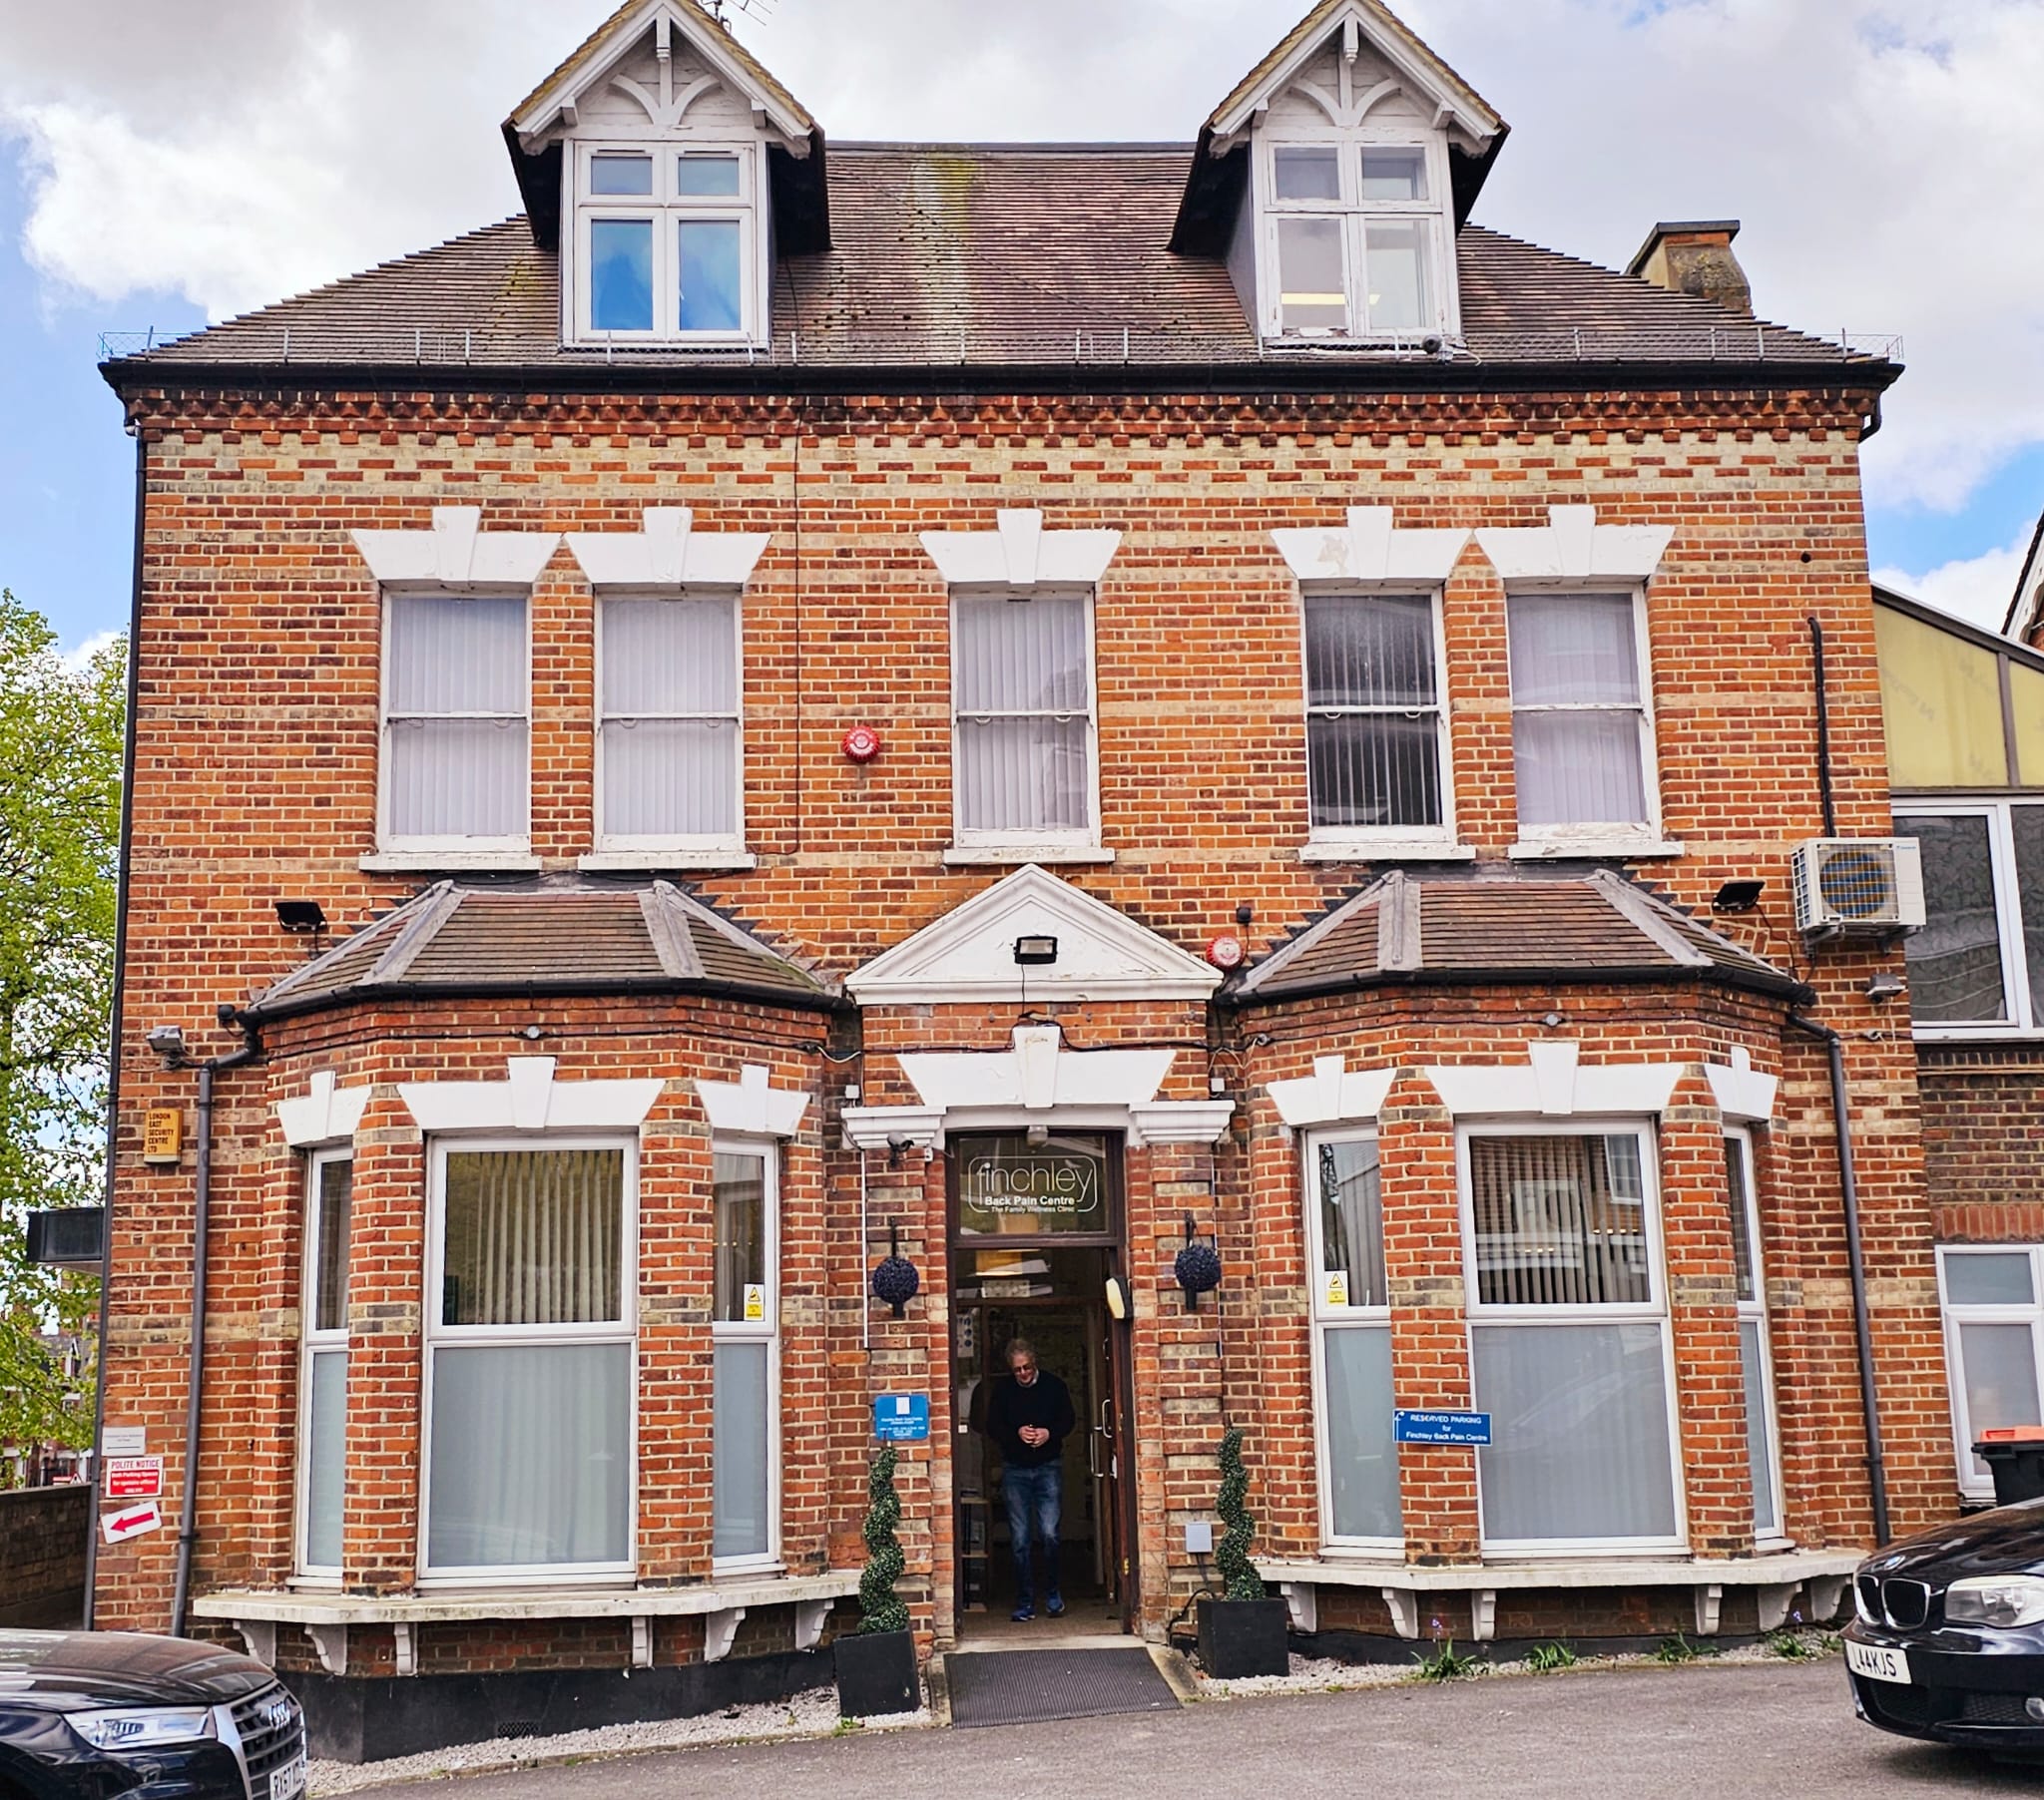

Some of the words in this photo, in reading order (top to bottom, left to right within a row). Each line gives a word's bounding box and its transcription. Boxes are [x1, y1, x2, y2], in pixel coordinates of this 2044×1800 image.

[976, 1159, 1093, 1205] finchley
[985, 1196, 1012, 1206] Back
[1014, 1196, 1038, 1206] Pain
[1039, 1195, 1075, 1206] Centre
[1410, 1414, 1449, 1423] RESERVED
[1405, 1431, 1432, 1441] Finchley
[111, 1461, 134, 1470] POLITE
